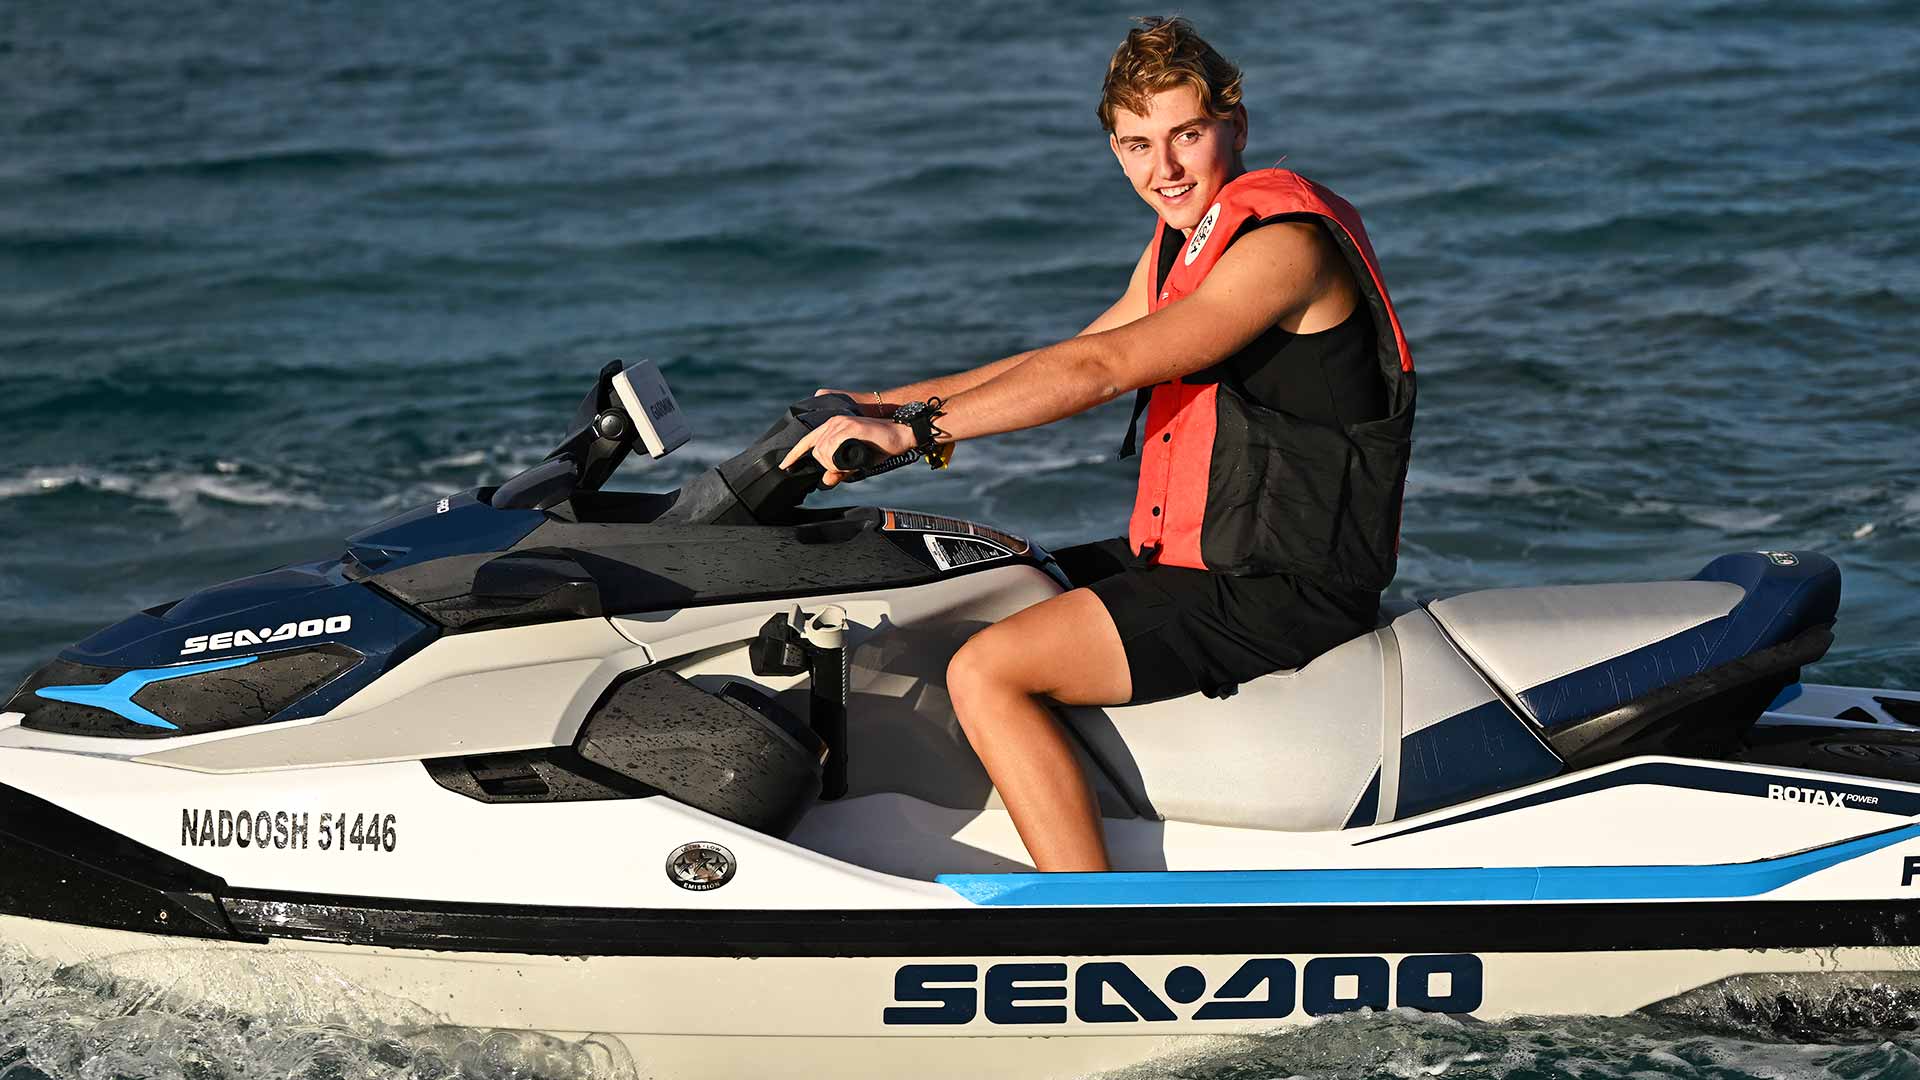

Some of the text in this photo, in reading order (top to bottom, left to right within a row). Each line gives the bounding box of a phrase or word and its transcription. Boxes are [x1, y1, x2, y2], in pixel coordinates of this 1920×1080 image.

[1768, 783, 1879, 808] ROTAX POWER
[181, 808, 397, 852] NADOOSH 51446
[683, 881, 720, 890] EMISSION
